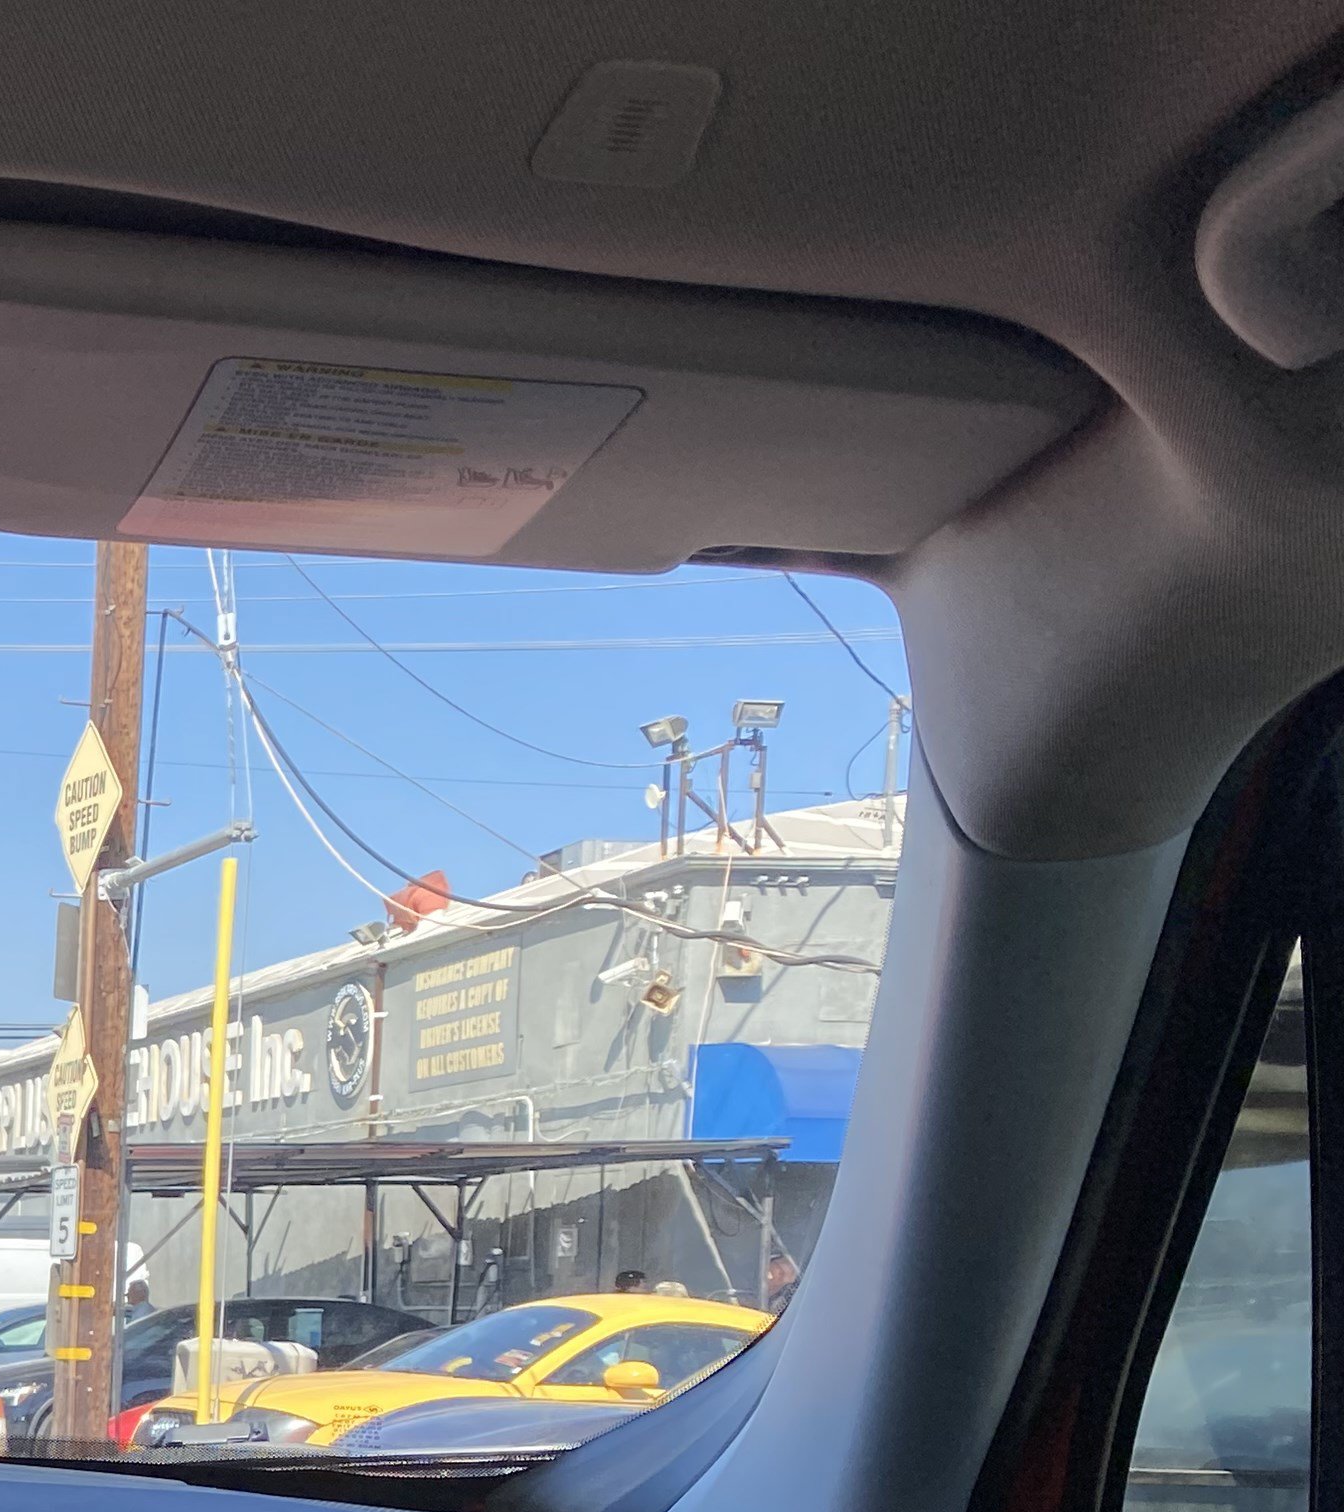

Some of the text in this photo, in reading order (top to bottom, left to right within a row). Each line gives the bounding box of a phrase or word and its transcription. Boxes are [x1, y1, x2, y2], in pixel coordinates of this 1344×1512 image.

[277, 364, 365, 378] WARNING
[65, 770, 107, 807] CAUTION
[69, 803, 99, 832] SPEED
[69, 828, 97, 856] BUMP
[415, 947, 515, 993] INSURANCE COMPANY
[416, 978, 509, 1021] REQUIRES A COPY OF
[420, 1011, 502, 1050] DRIVER'S LICENSE
[250, 1014, 311, 1102] Inc.
[416, 1042, 505, 1080] ON ALL CUSTOMERS
[57, 1090, 77, 1112] SPEED
[54, 1176, 77, 1192] SPEED
[55, 1193, 75, 1208] LIMIT
[58, 1216, 69, 1245] 5
